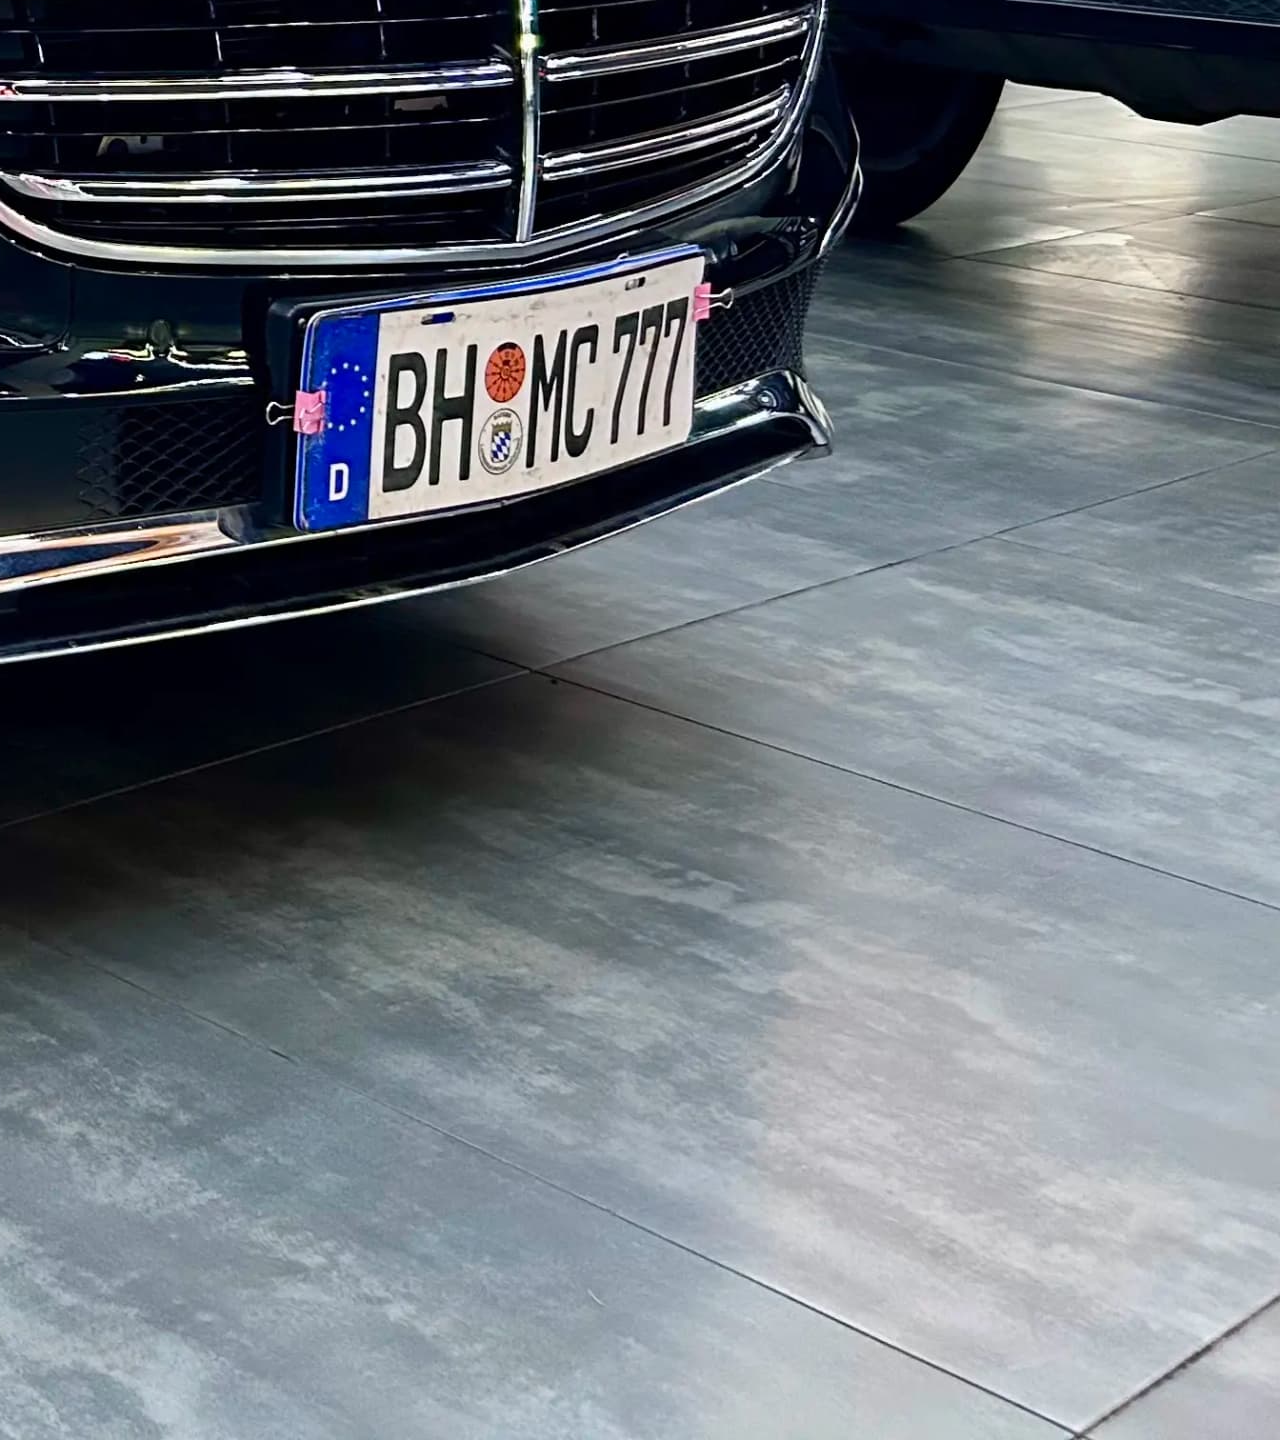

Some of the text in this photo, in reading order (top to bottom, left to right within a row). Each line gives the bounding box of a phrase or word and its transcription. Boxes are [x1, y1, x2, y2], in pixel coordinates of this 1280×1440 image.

[382, 296, 689, 492] BH MC 777
[328, 461, 349, 502] D
